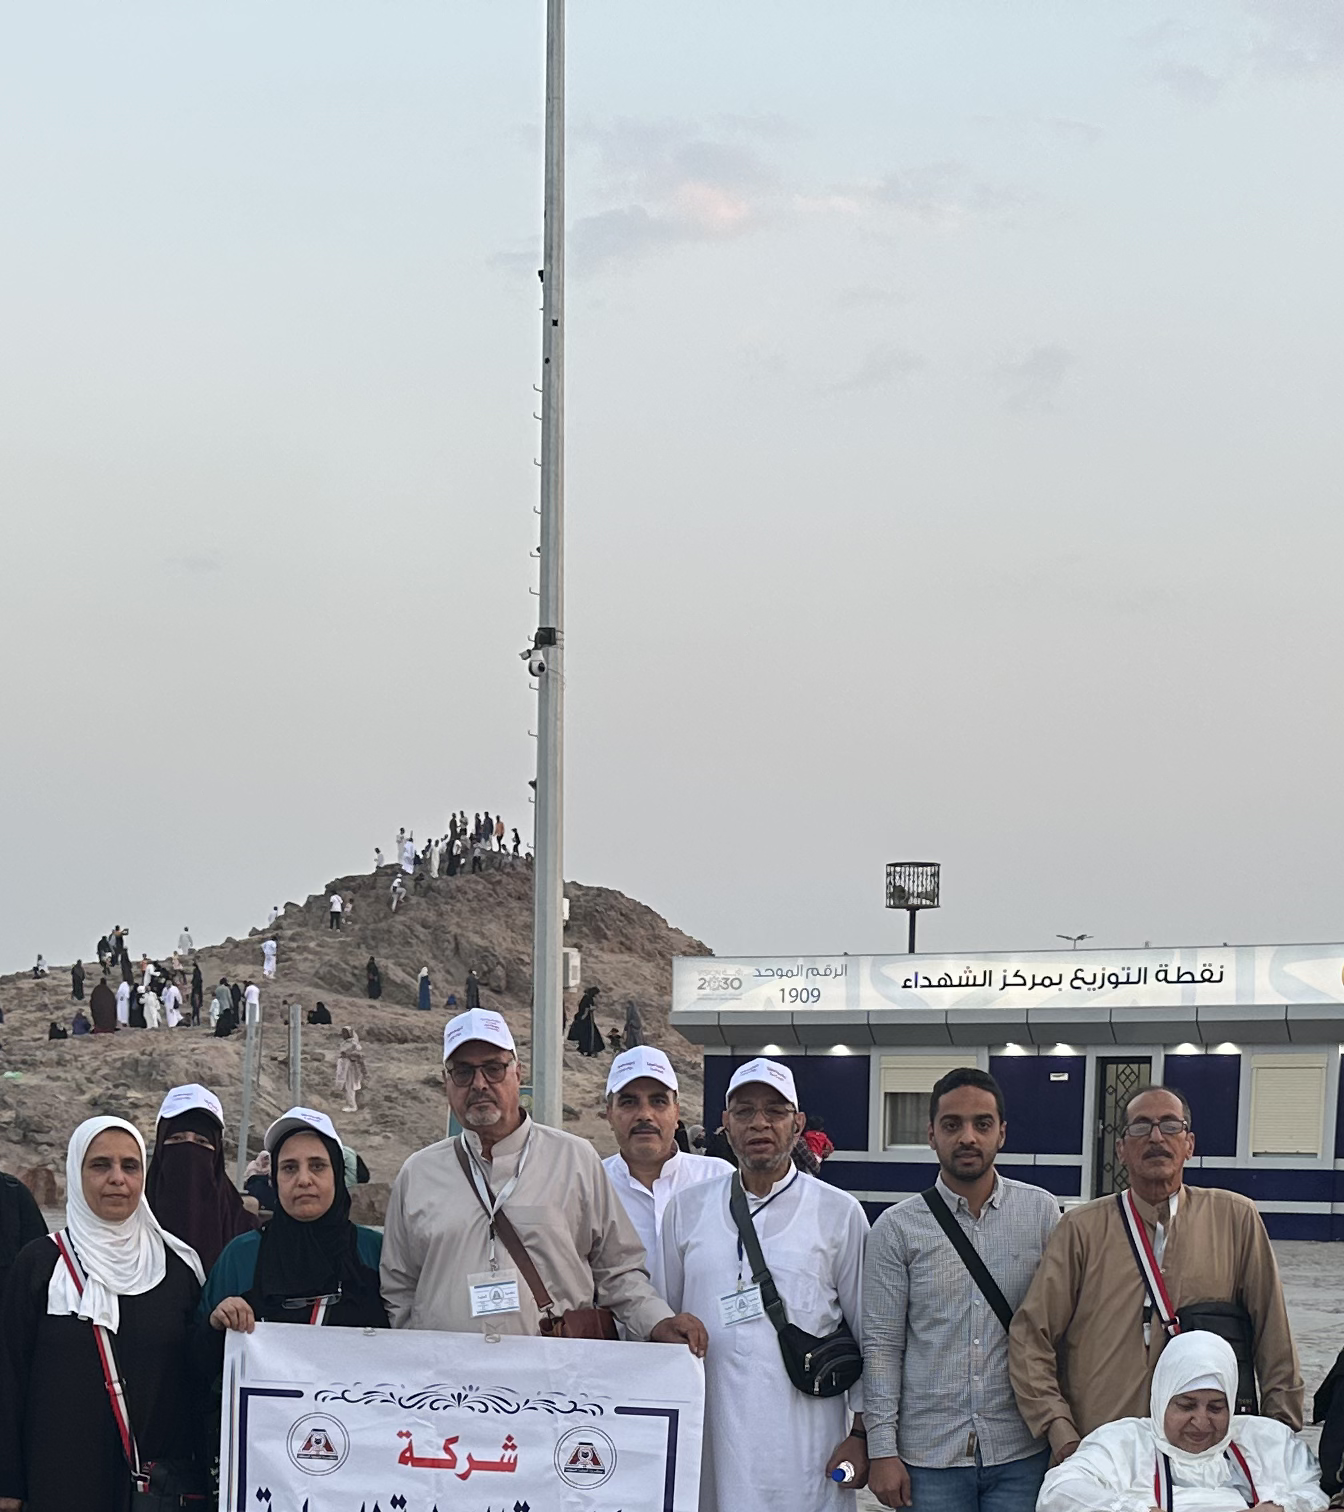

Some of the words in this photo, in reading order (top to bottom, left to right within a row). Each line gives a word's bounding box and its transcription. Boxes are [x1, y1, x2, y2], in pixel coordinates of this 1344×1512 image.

[752, 964, 804, 979] الموحد
[806, 964, 848, 980] الرقم
[901, 966, 993, 989] الشهداء
[998, 968, 1063, 992] بمركز
[1069, 966, 1148, 992] التوزيع
[1154, 963, 1224, 985] نقطة
[780, 987, 821, 1004] 1909
[397, 1430, 518, 1481] شركة
